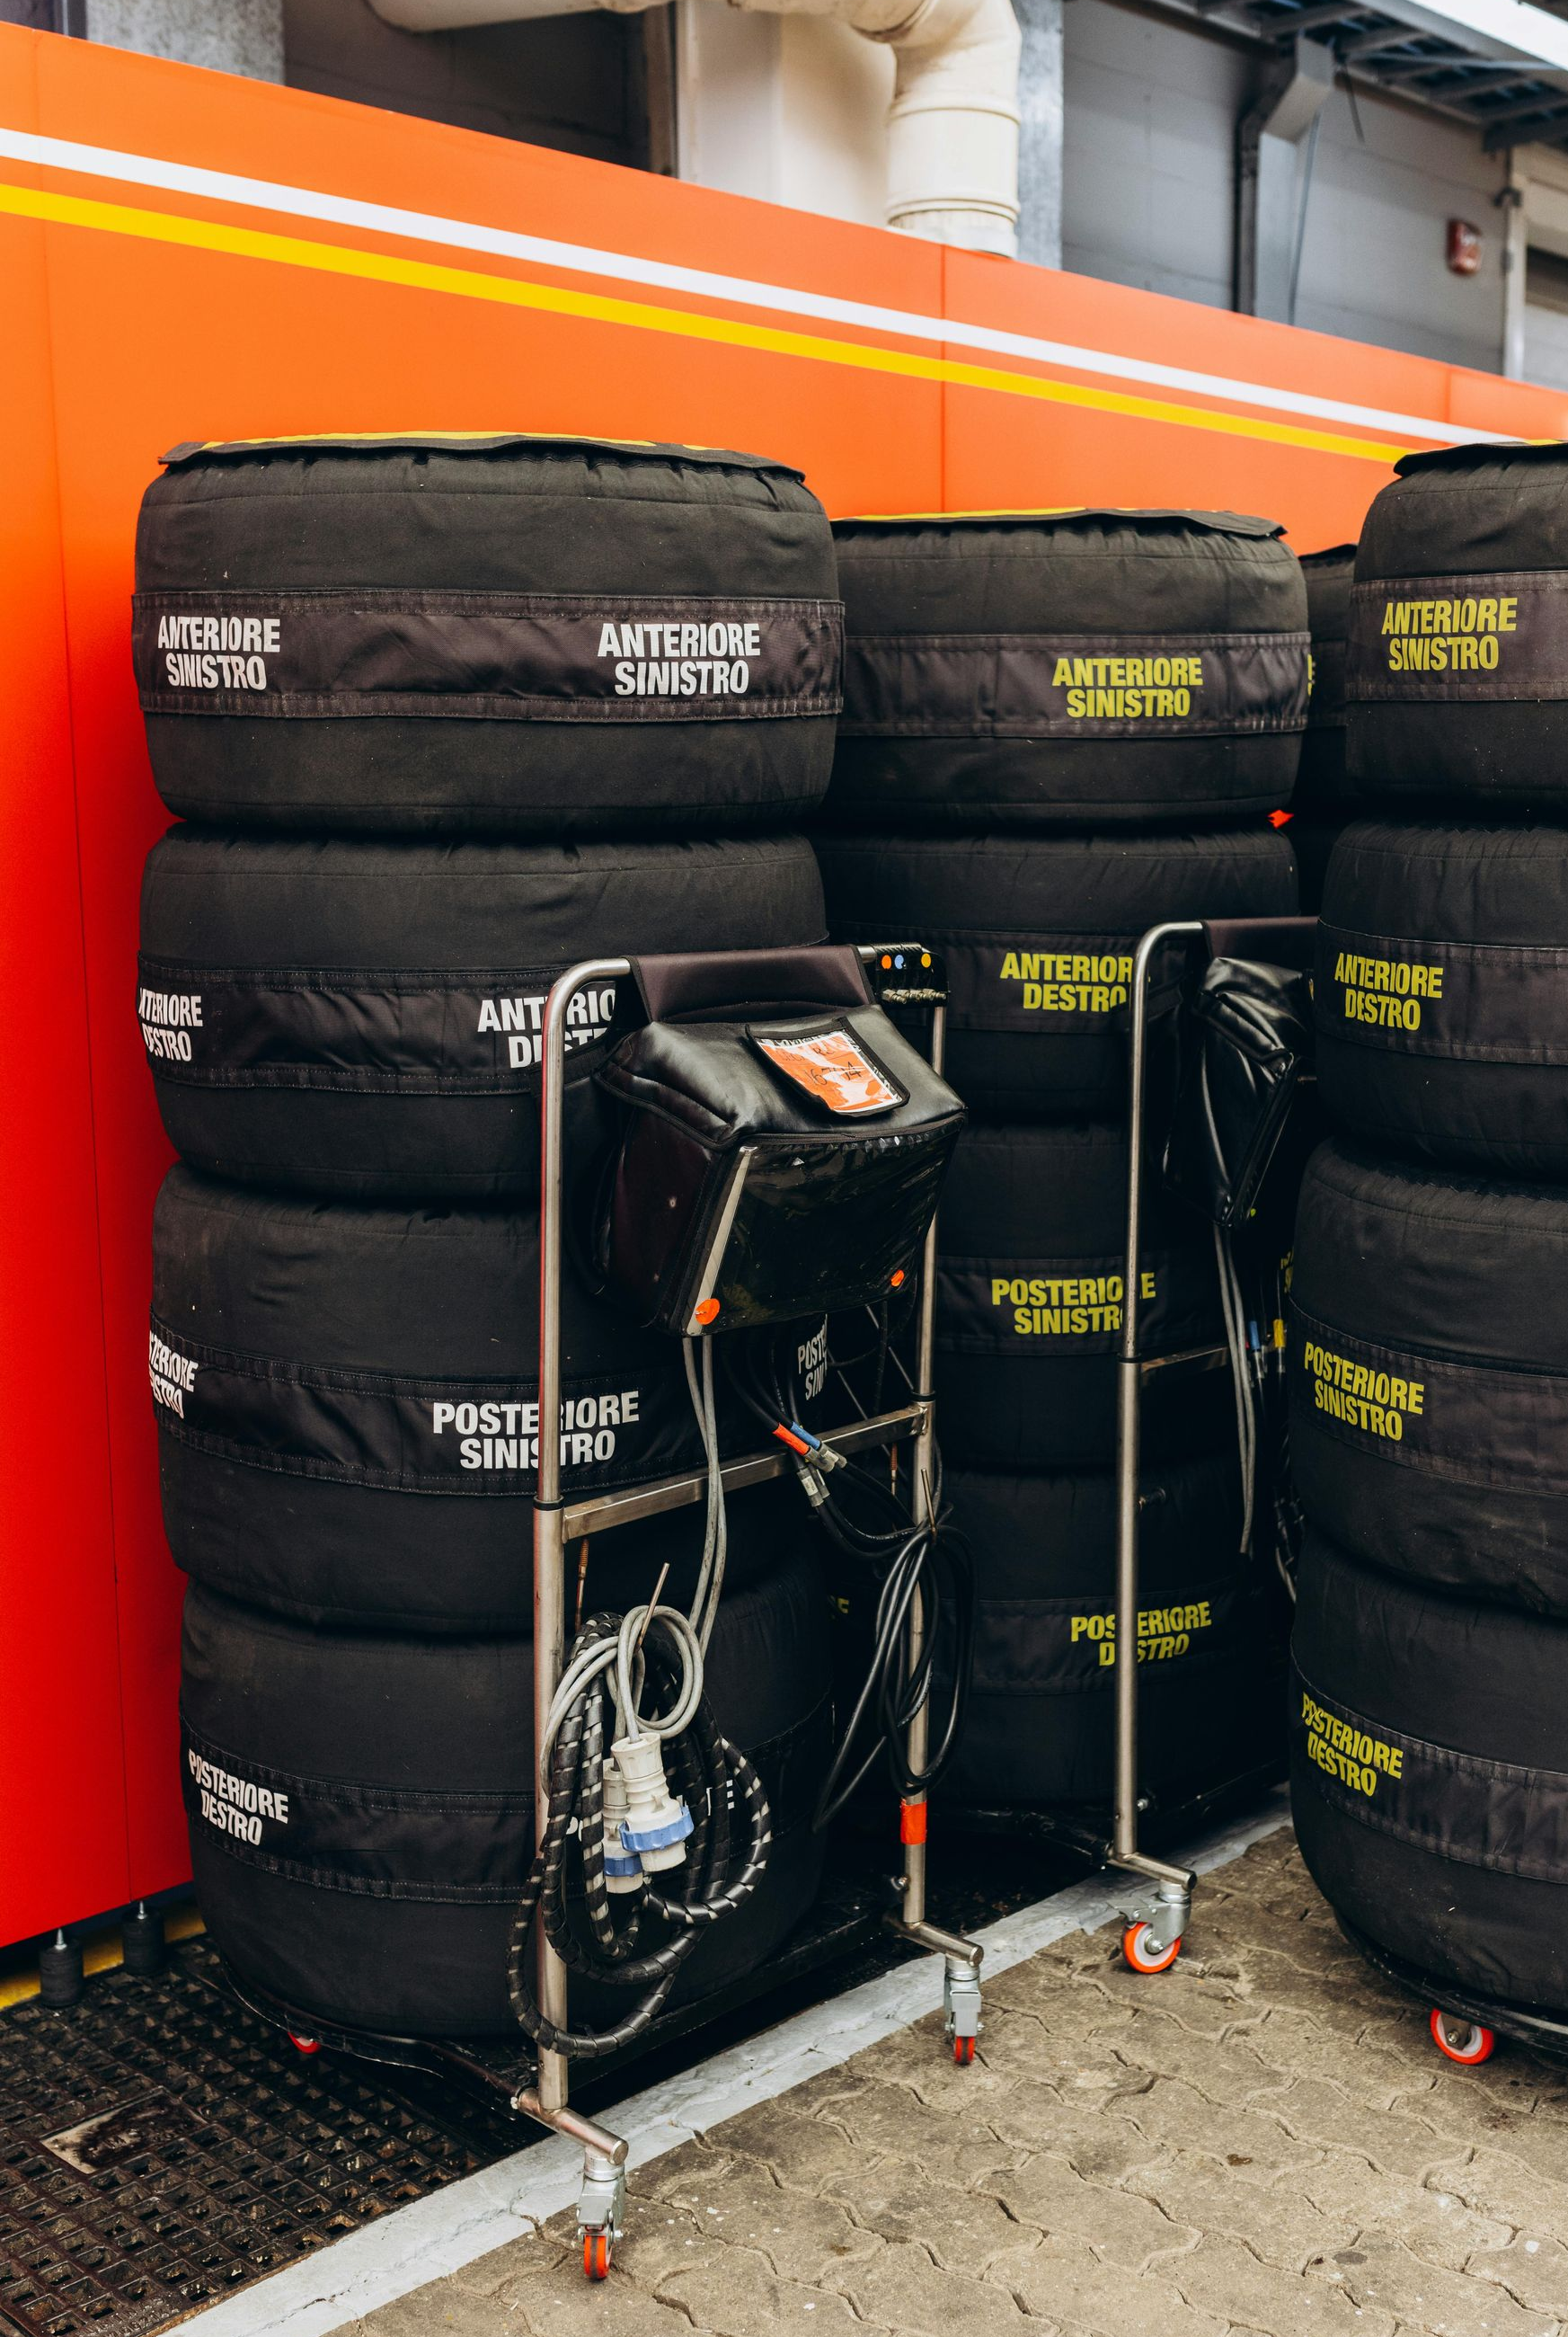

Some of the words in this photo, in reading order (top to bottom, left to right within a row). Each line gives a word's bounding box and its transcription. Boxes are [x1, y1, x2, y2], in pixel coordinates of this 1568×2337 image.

[157, 613, 281, 653] ANTERIORE
[1380, 595, 1519, 636] ANTERIORE
[597, 620, 762, 659] ANTERIORE
[1387, 634, 1501, 672] SINISTRO
[165, 653, 268, 692] SINISTRO
[614, 660, 751, 697] SINISTRO
[1052, 656, 1205, 688] ANTERIORE
[1066, 688, 1192, 719] SINISTRO
[999, 952, 1150, 983] ANTERIOR
[1333, 951, 1445, 999] ANTERIORE
[477, 989, 616, 1033] ANTRIO
[1023, 982, 1127, 1012] DESTRO
[1344, 988, 1422, 1031] DESTRO
[991, 1272, 1156, 1307] POSTERIOE
[1014, 1305, 1123, 1335] SINISTR
[1304, 1341, 1425, 1416] POSTERIORE
[1315, 1378, 1404, 1442] SINISTRO
[1070, 1600, 1213, 1643] POSERIORE
[1098, 1632, 1191, 1667] DSTRO
[1301, 1691, 1404, 1780] POSTERIORE
[1307, 1730, 1378, 1798] DESTRO
[188, 1747, 289, 1825] POSTERIORE
[200, 1788, 263, 1846] DESTRO
